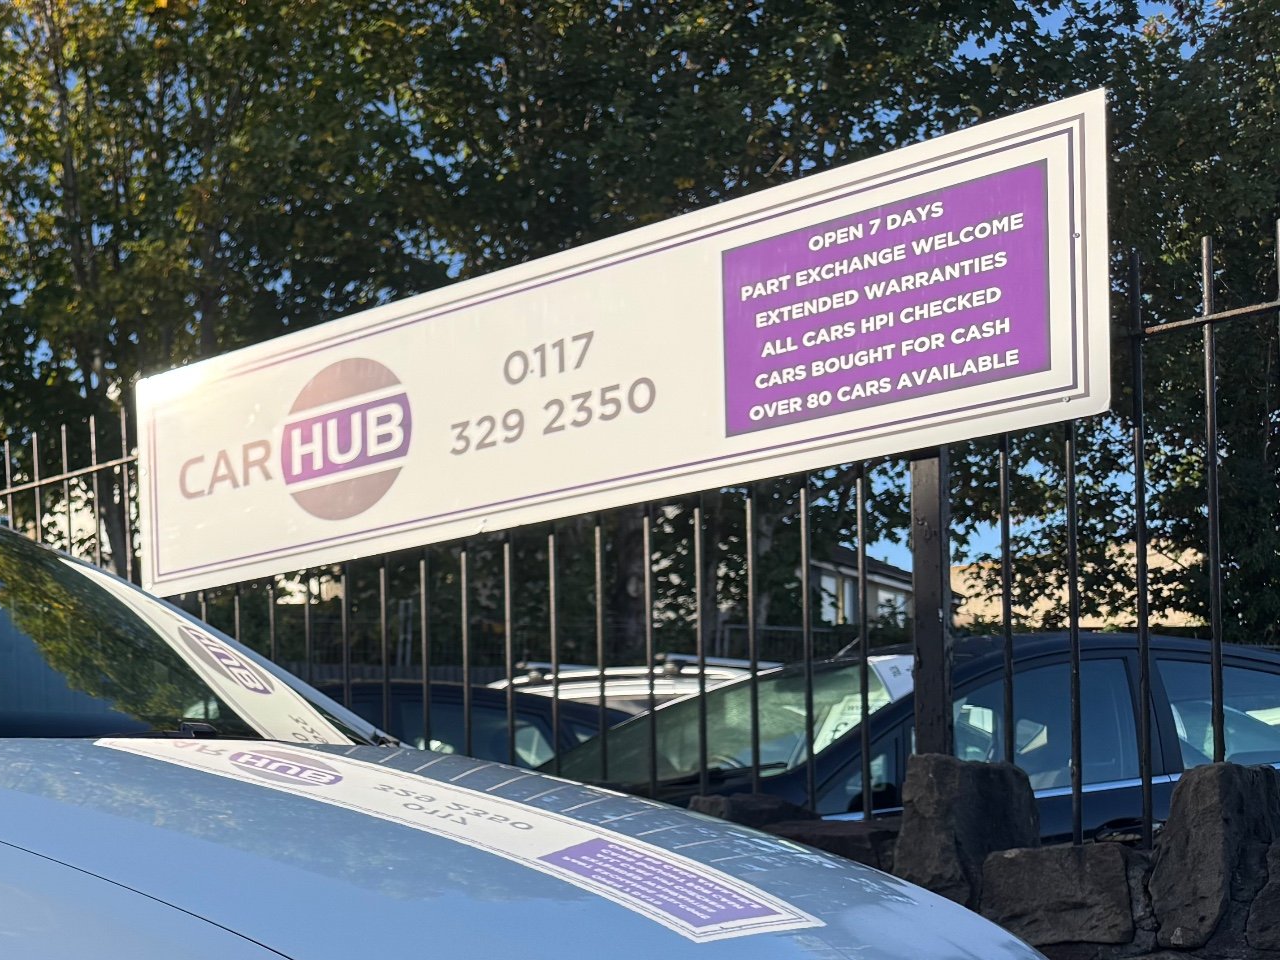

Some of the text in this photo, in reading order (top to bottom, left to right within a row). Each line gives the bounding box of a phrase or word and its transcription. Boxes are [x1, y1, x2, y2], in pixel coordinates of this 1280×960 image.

[741, 212, 1024, 302] PART EXCHANGE WELCOME
[808, 201, 944, 252] OPEN 7 DAYS
[755, 251, 1008, 328] EXTENDED WARRANTIES
[761, 287, 1002, 358] ALL CARS HPI CHECKED
[503, 331, 595, 385] 0117
[748, 349, 1019, 421] OVER 80 CARS AVAILABLE
[754, 318, 1010, 389] CARS BOUGHT FOR CASH
[179, 403, 406, 500] CAR HUB
[450, 377, 656, 456] 329 2350
